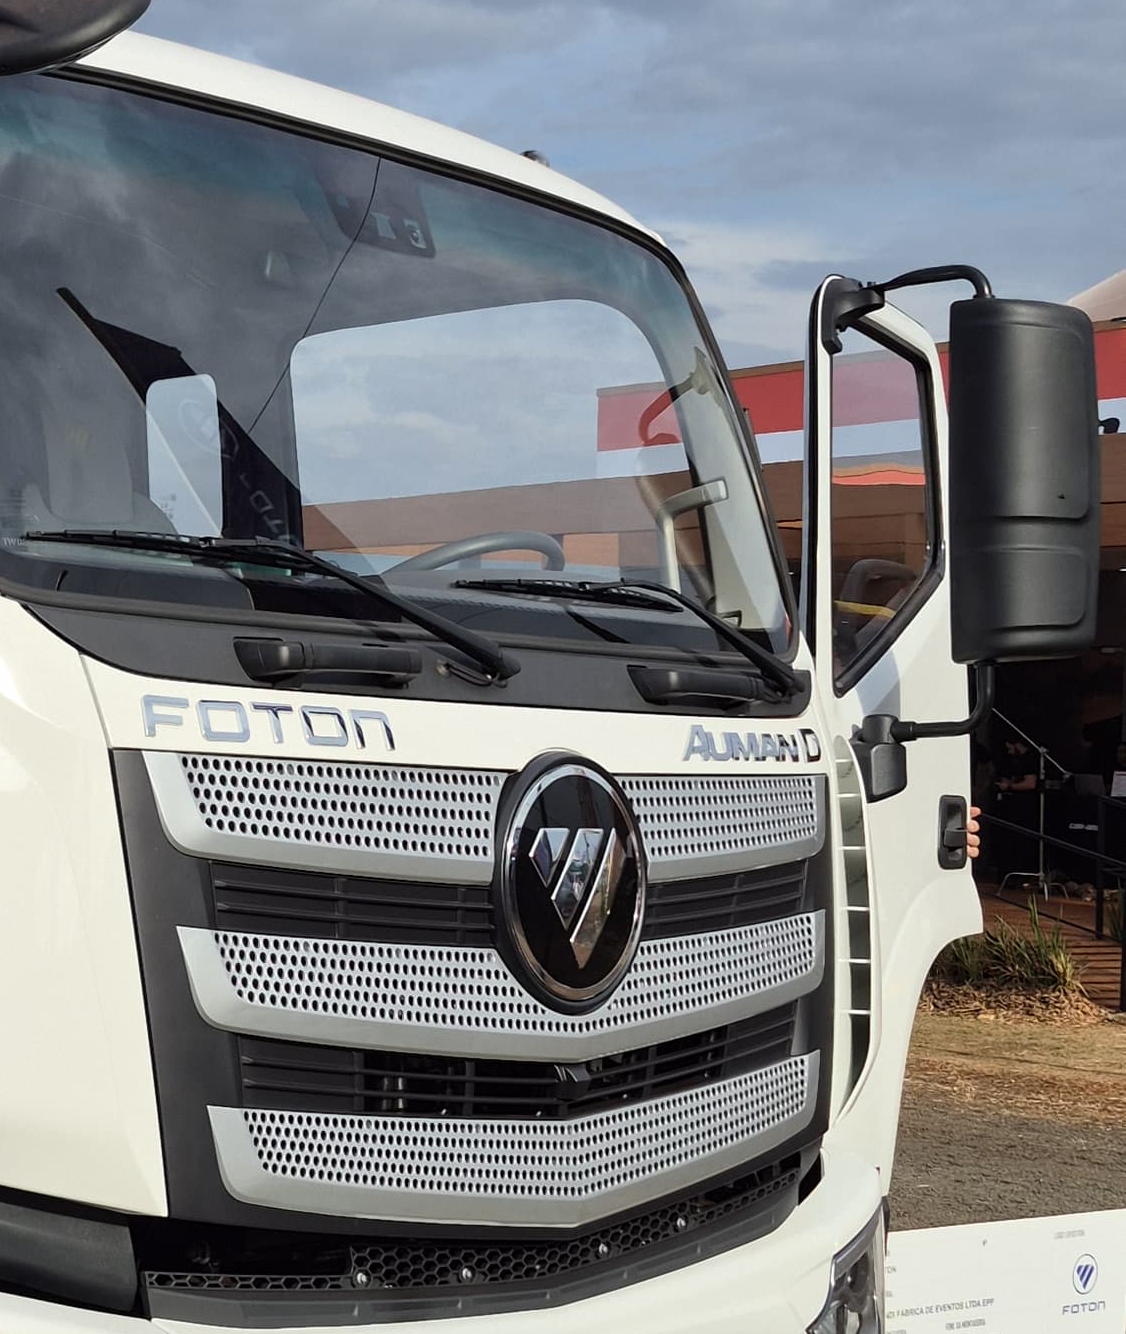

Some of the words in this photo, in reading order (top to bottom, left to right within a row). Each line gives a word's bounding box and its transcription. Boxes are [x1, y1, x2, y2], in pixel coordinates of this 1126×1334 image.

[140, 693, 396, 751] FOTON
[682, 724, 799, 763] AUMAN
[797, 727, 822, 763] D
[1061, 1300, 1106, 1316] FOTON
